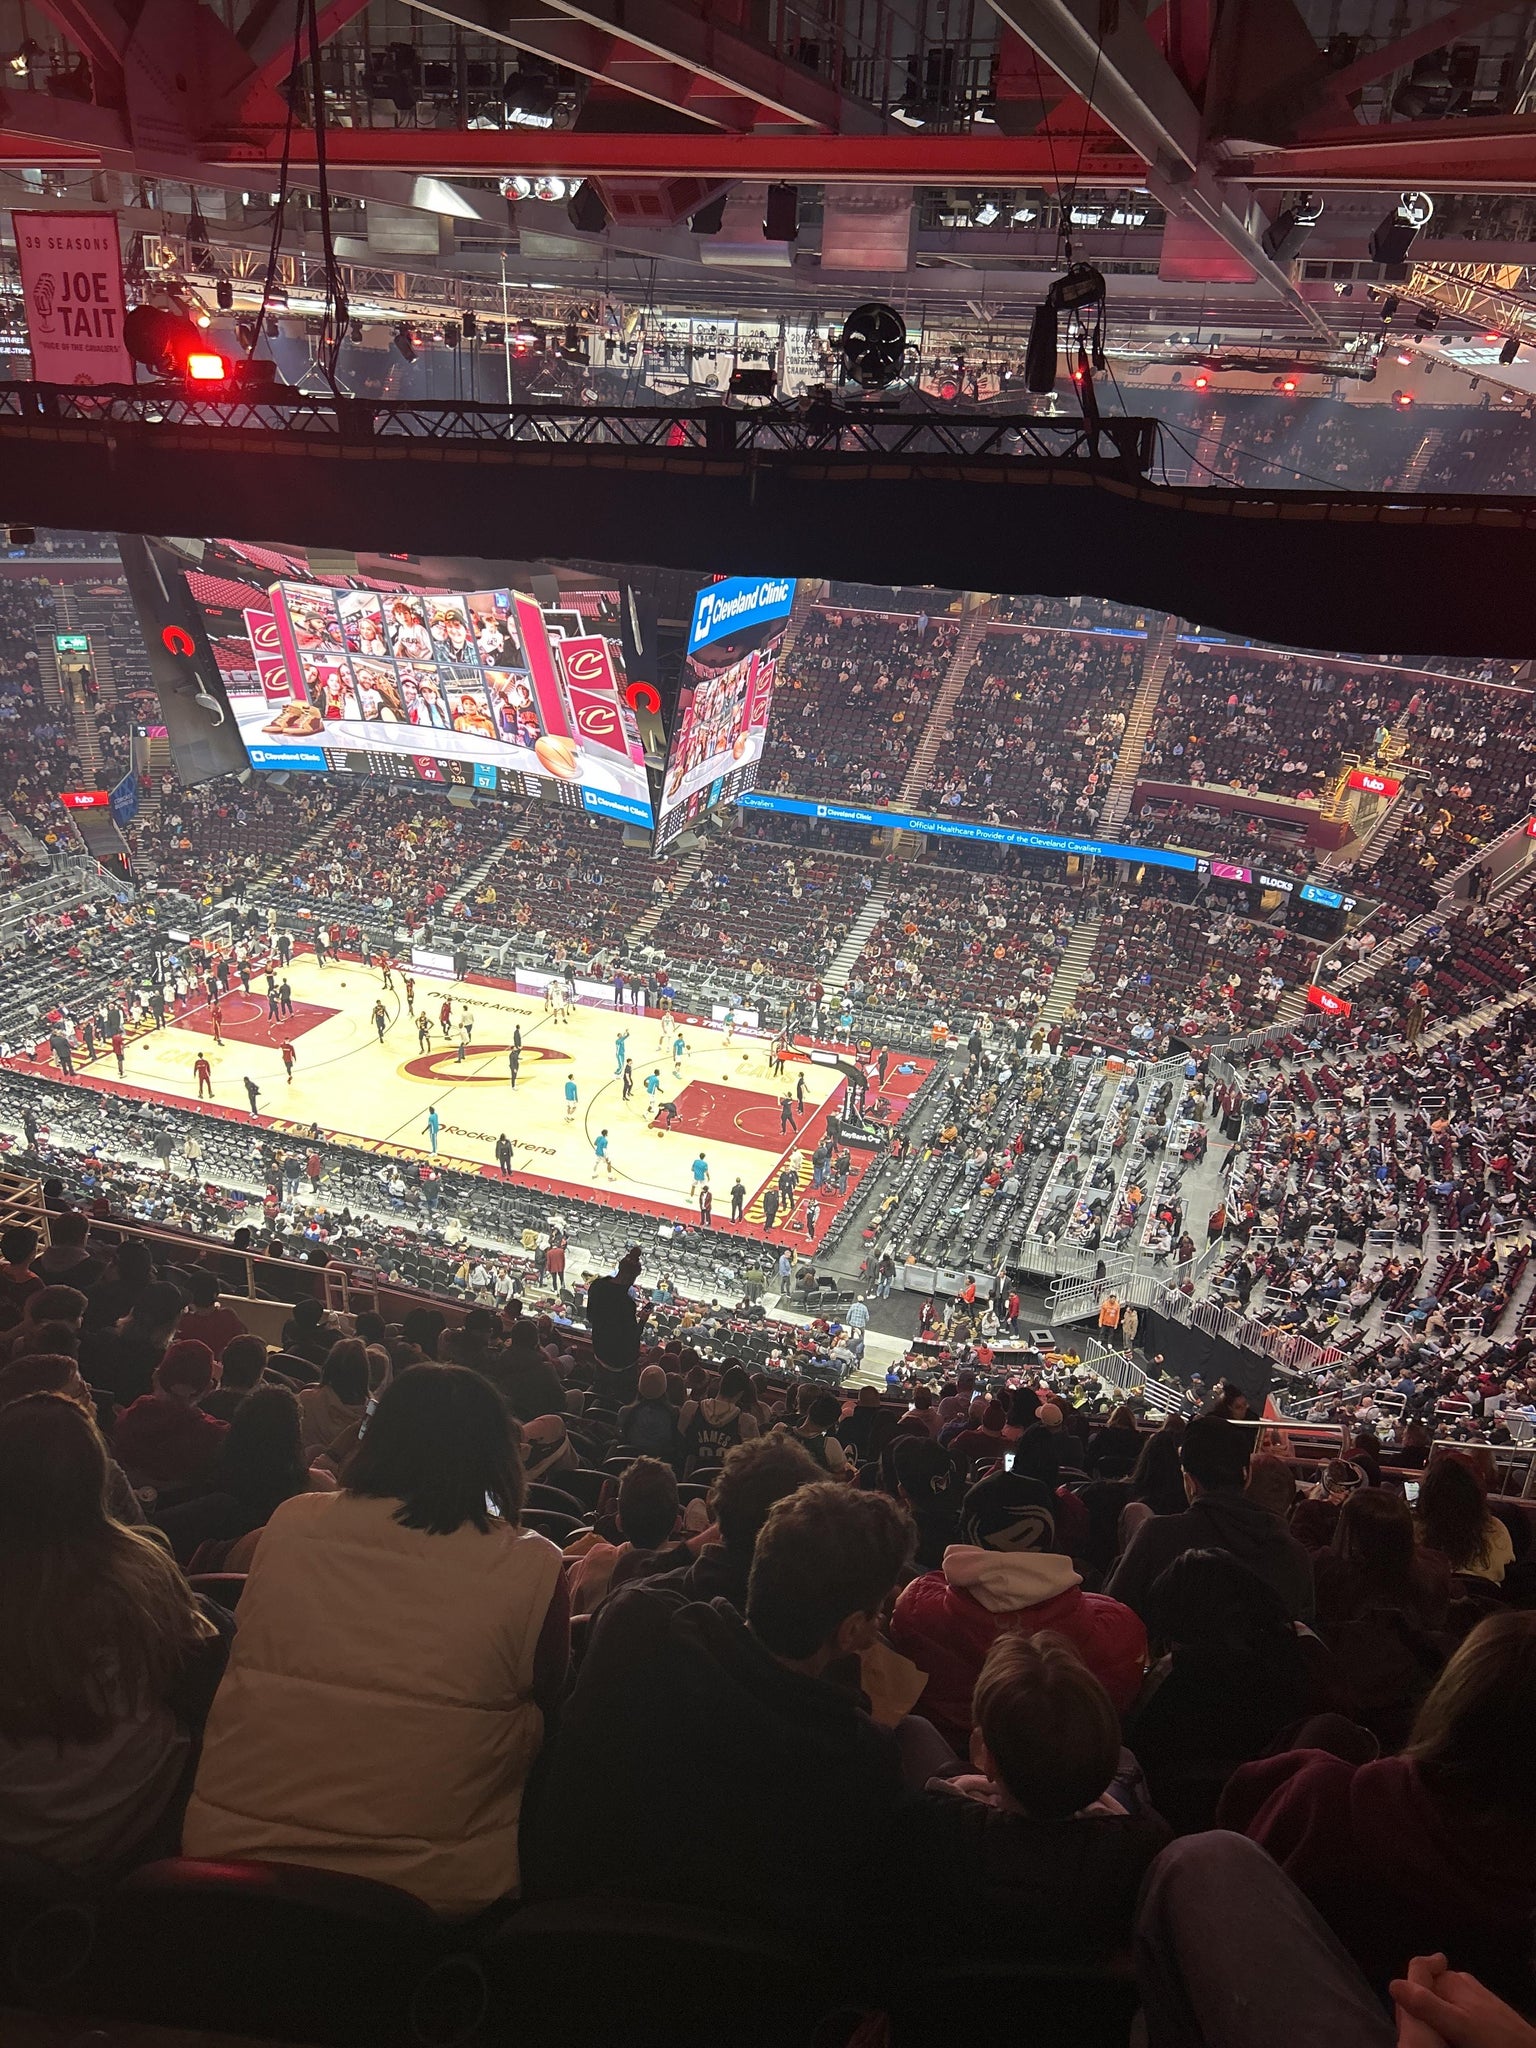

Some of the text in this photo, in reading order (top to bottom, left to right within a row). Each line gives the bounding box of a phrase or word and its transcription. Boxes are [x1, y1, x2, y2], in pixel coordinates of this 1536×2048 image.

[26, 237, 109, 250] 39 SEASONS
[61, 272, 110, 303] JOE
[57, 307, 116, 338] TAIT
[712, 579, 789, 624] Cleveland Clinic
[264, 752, 321, 762] Cleveland Clinic
[424, 769, 436, 779] 47
[478, 777, 490, 787] 57
[1362, 776, 1385, 791] fubo
[74, 796, 94, 804] fubo
[744, 796, 775, 808] Cavaliers
[597, 796, 649, 819] Cleveland Clinic
[827, 808, 873, 821] Cleveland Clinic
[909, 820, 936, 831] Official
[936, 824, 975, 836] Healthcare
[975, 829, 1005, 840] Provider
[1016, 835, 1029, 844] the
[1030, 836, 1066, 849] Cleveland
[1067, 841, 1102, 853] Cavaliers
[1235, 869, 1244, 880] 2
[1259, 875, 1294, 892] BLOCKS
[1307, 888, 1315, 899] 5
[440, 993, 533, 1016] Rocket Arena
[1321, 995, 1339, 1009] fubo
[444, 1125, 557, 1156] Rocke Arena
[841, 1130, 867, 1142] KeyBank
[697, 1430, 731, 1448] JAMES
